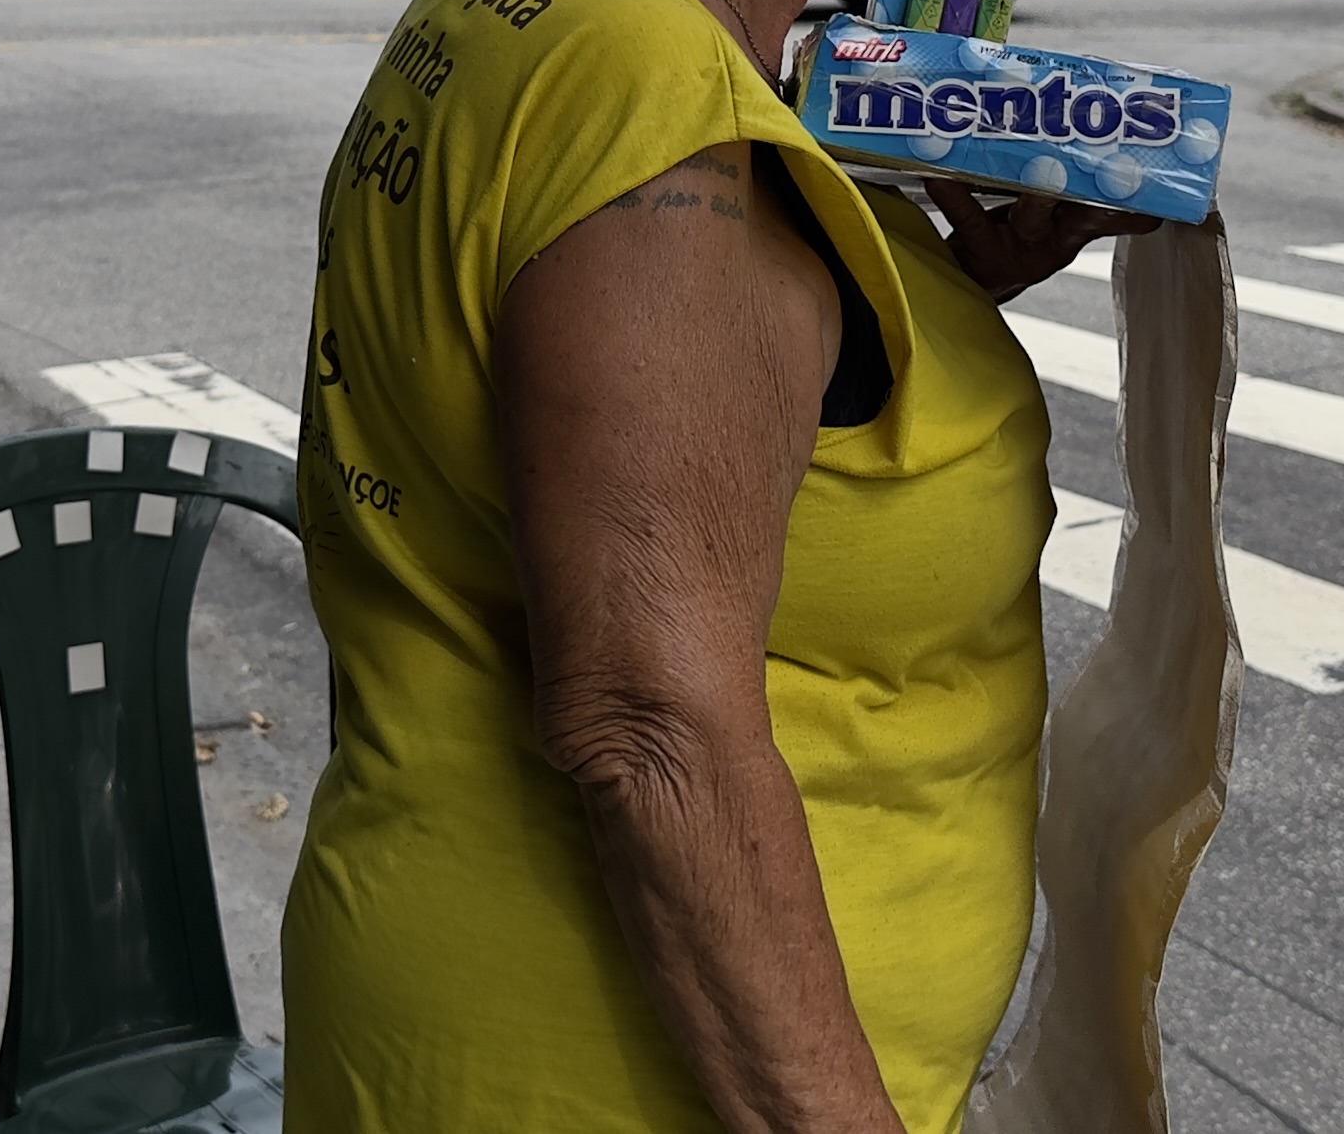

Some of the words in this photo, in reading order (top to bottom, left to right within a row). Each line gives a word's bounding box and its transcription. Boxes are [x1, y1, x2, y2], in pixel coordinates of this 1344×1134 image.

[833, 38, 907, 62] mint
[831, 74, 1179, 142] mentos
[346, 104, 420, 205] AÇÃO
[319, 328, 351, 395] S.
[338, 462, 402, 518] NÇOE
